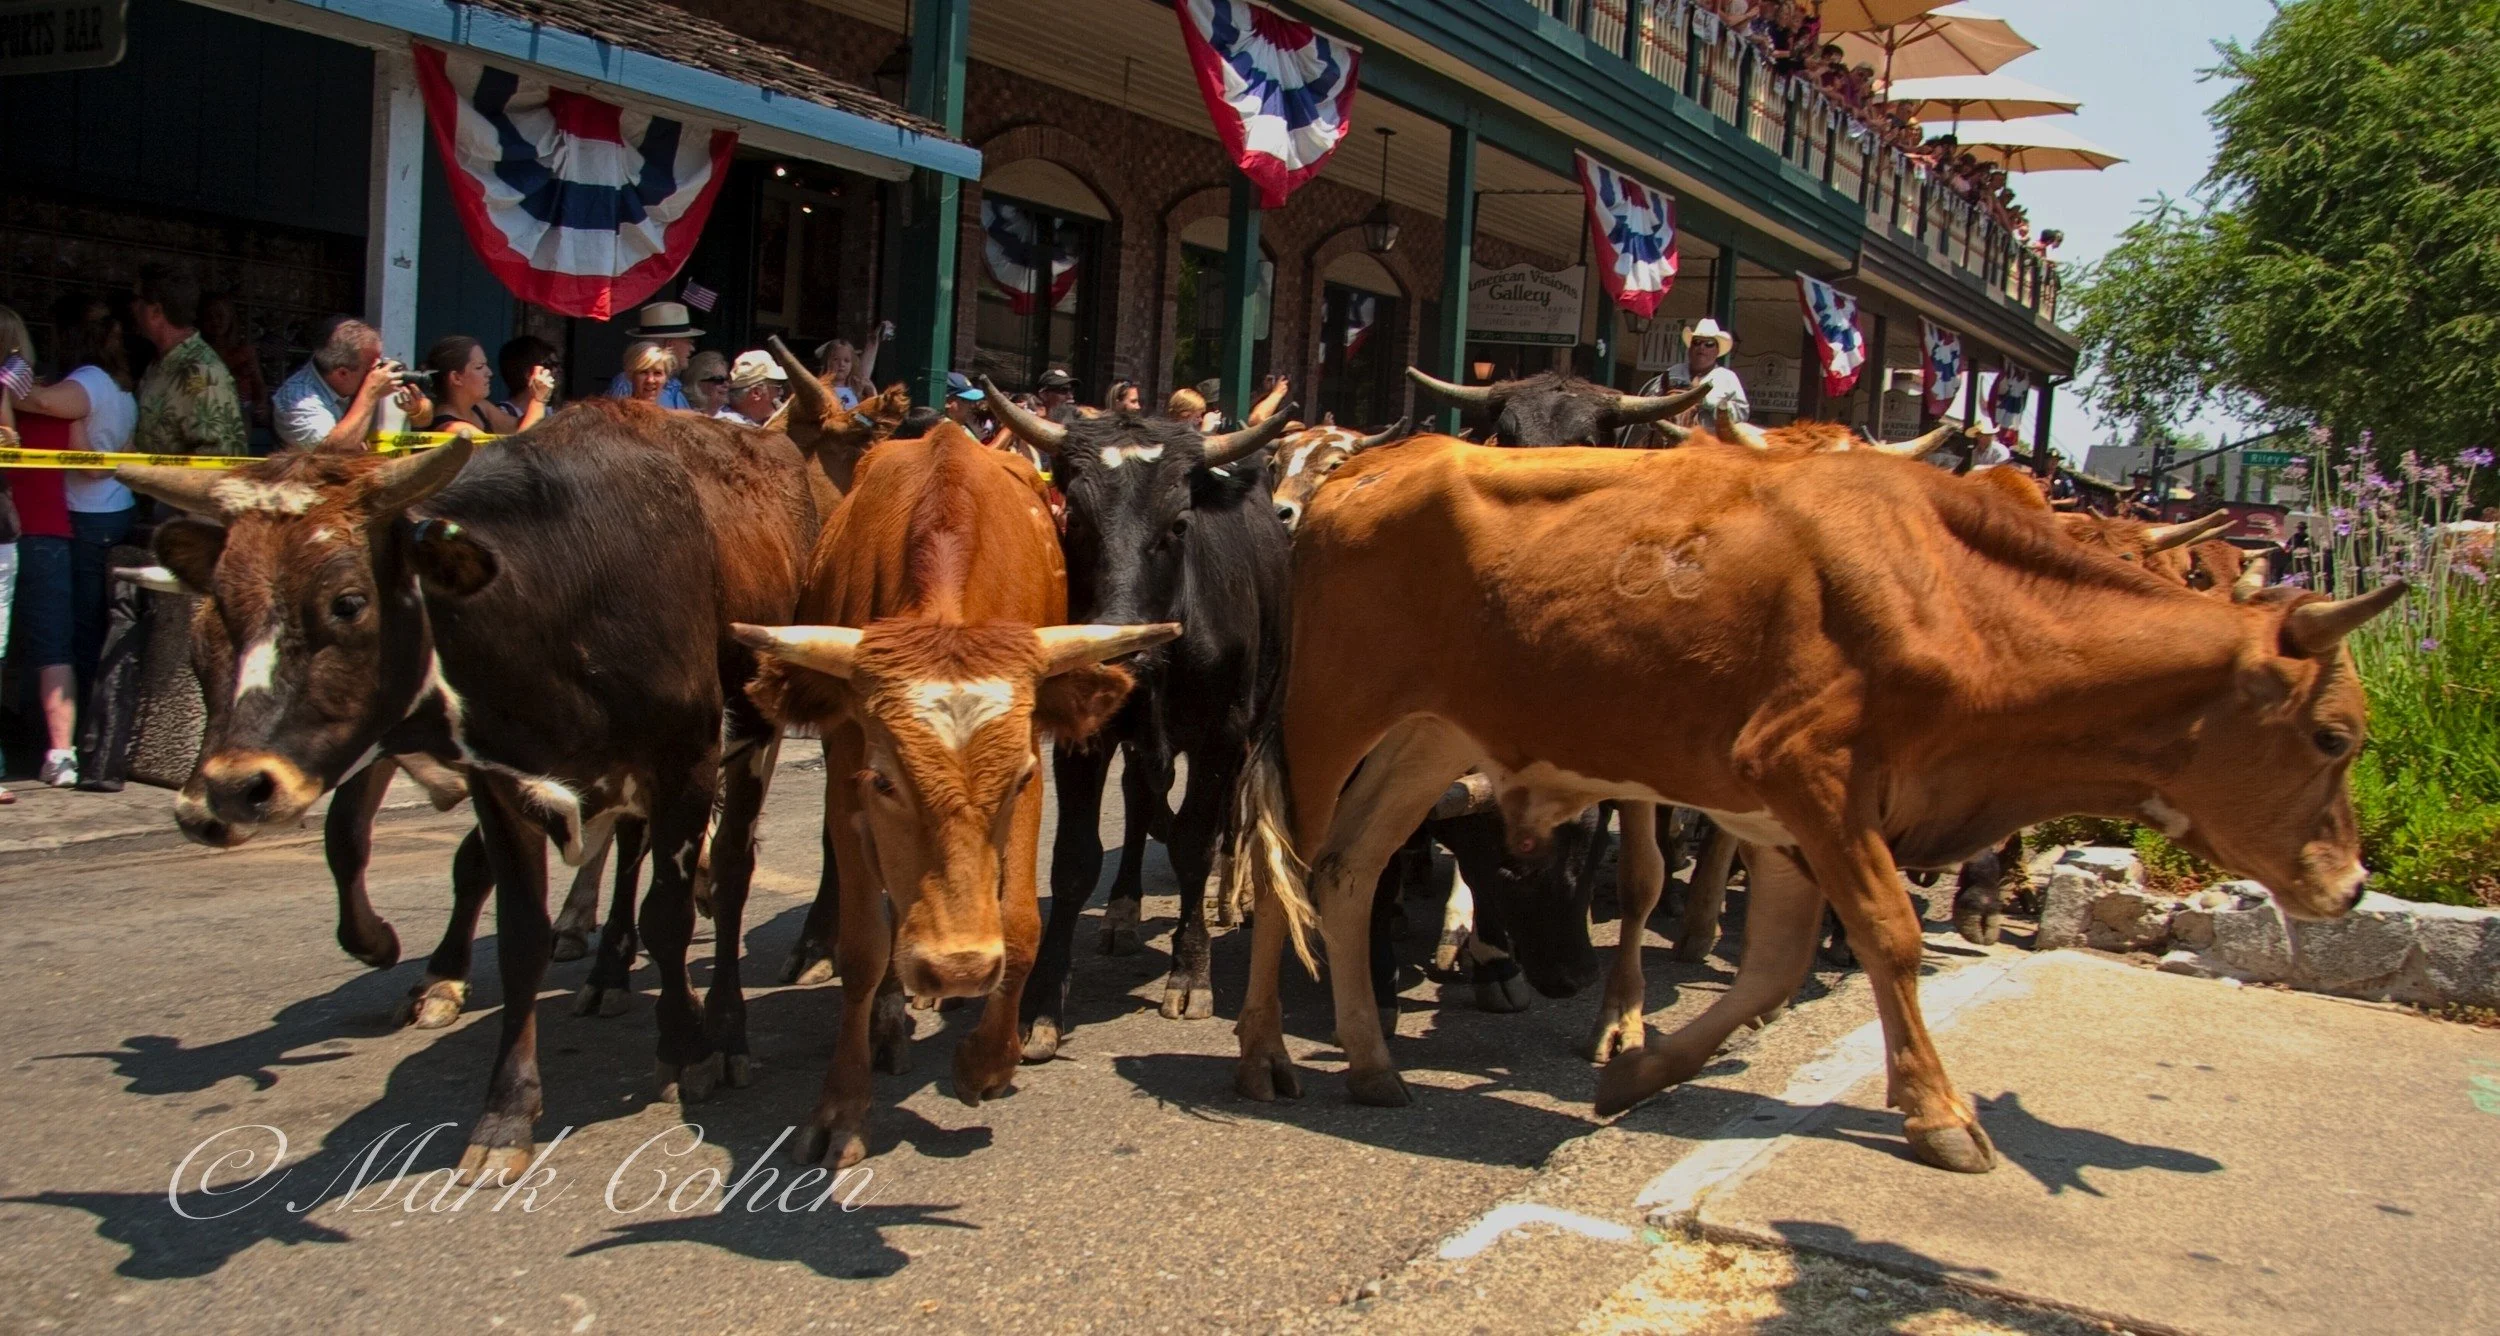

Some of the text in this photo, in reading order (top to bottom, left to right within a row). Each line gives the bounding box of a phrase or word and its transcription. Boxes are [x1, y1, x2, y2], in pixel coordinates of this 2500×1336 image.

[64, 6, 104, 52] BAR
[1489, 284, 1551, 307] Gallery
[1530, 270, 1578, 299] Visions
[2251, 453, 2280, 465] Riley
